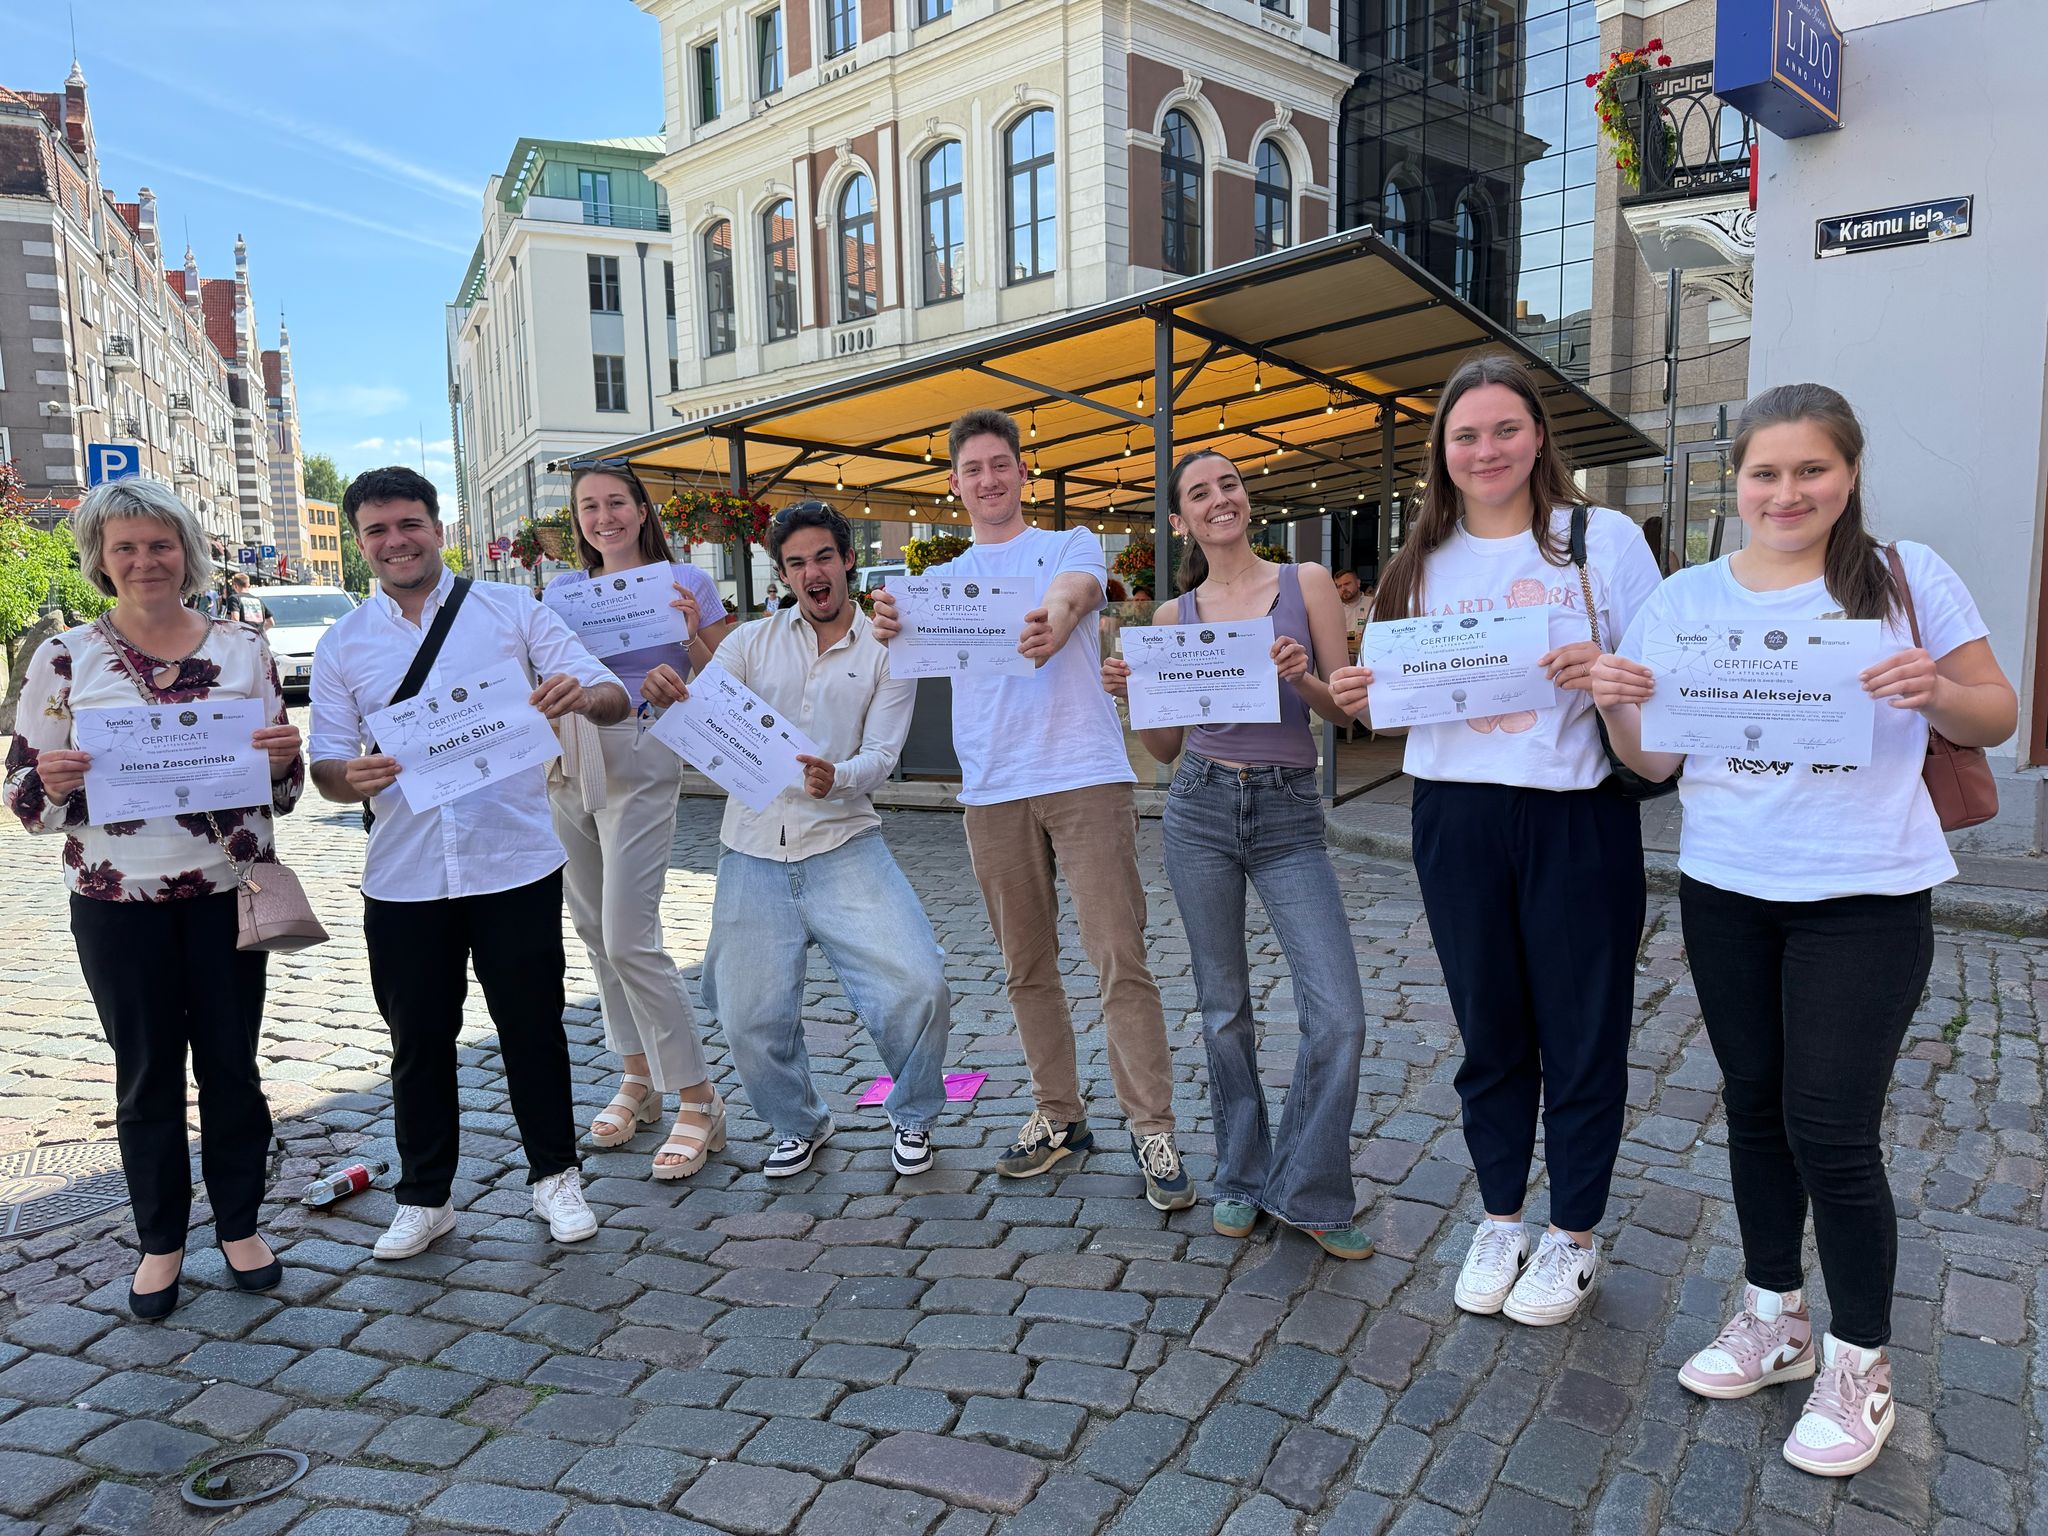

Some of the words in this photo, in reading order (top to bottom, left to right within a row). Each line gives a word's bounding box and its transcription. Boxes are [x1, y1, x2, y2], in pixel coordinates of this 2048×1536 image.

[1787, 9, 1832, 79] LIDO
[1786, 57, 1808, 80] ANNO
[1839, 216, 1902, 242] Krāmu
[100, 449, 128, 482] P
[591, 593, 638, 609] CERTIFICATE
[934, 604, 987, 612] CERTIFICATE
[582, 615, 626, 626] Anastasija
[627, 608, 655, 619] Bikova
[917, 626, 975, 634] Maximiliano
[977, 627, 1006, 636] López
[1421, 632, 1487, 646] CERTIFICATE
[1170, 648, 1226, 659] CERTIFICATE
[1403, 660, 1447, 674] Polina
[1450, 653, 1508, 668] Glonina
[1714, 659, 1798, 670] CERTIFICATE
[1158, 671, 1193, 680] Irene
[1196, 667, 1245, 679] Puente
[1680, 687, 1739, 699] Vasilisa
[1742, 689, 1832, 703] Aleksejeva
[428, 702, 485, 730] CERTIFICATE
[728, 709, 770, 745] CERTIFICATE
[142, 732, 209, 745] CERTIFICATE
[428, 733, 470, 756] André
[472, 720, 506, 739] Silva
[706, 718, 729, 739] Pedro
[729, 737, 762, 766] Carvalho
[120, 761, 160, 772] Jelena
[162, 754, 235, 769] Zascerinska
